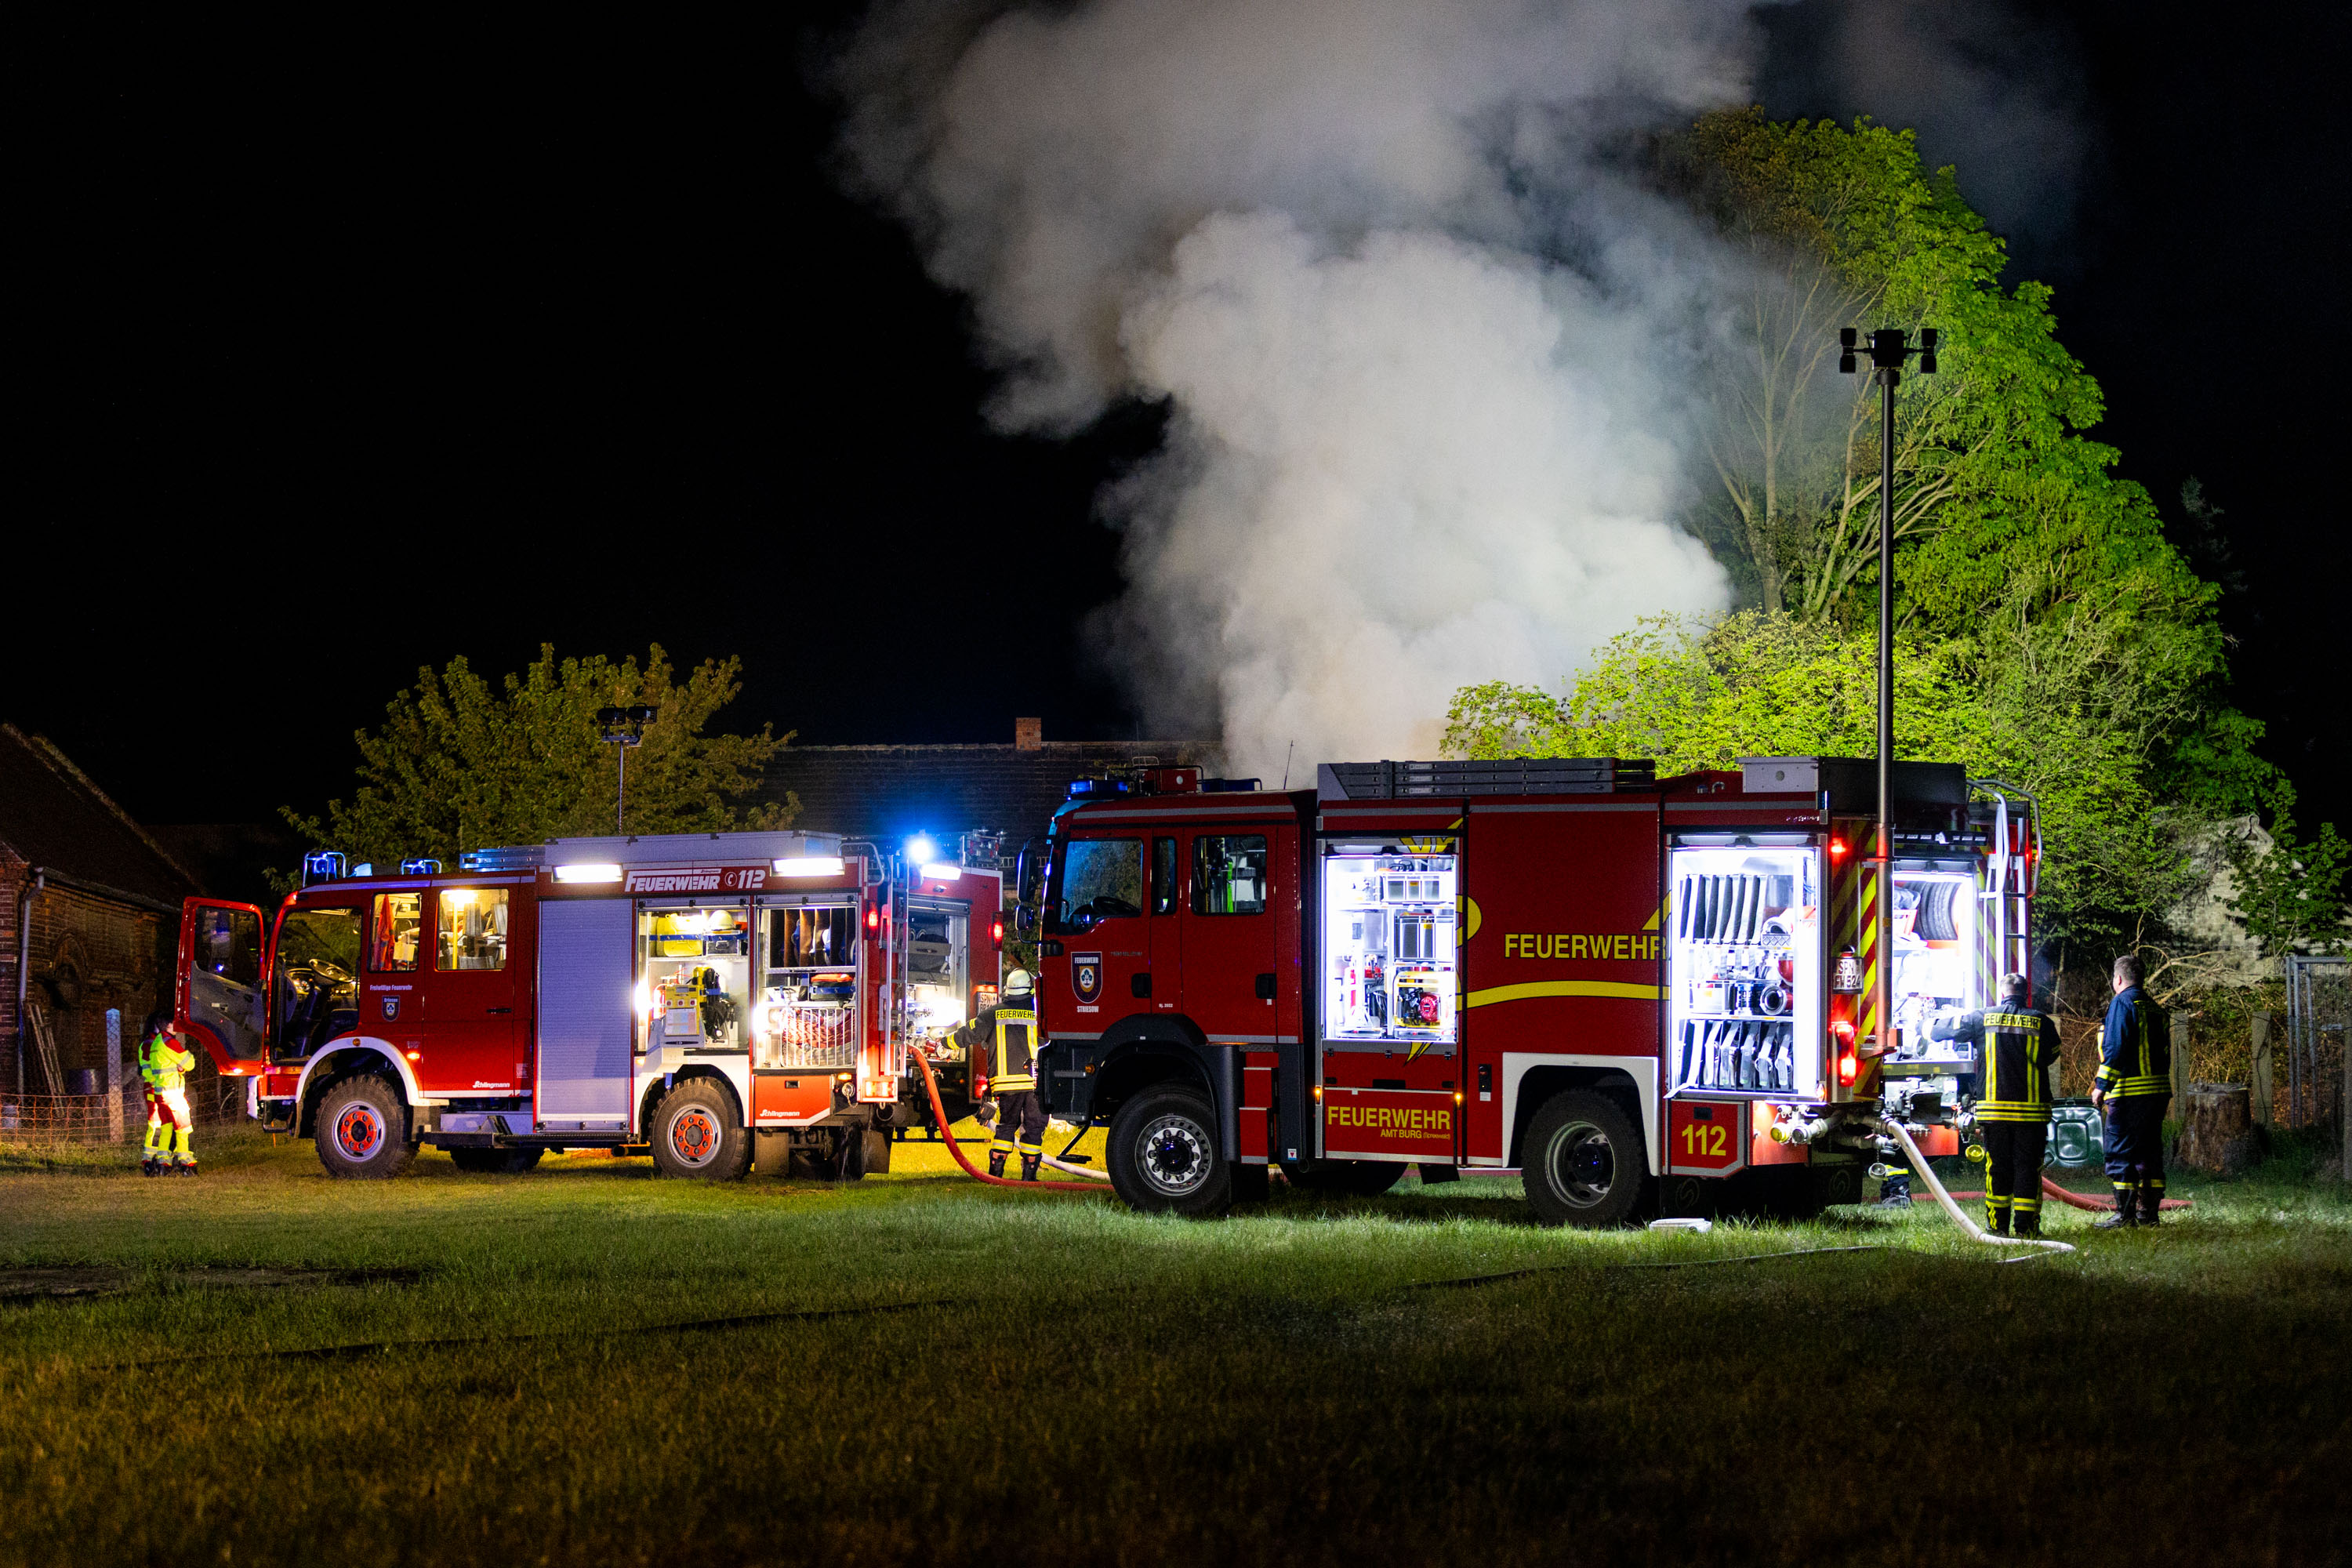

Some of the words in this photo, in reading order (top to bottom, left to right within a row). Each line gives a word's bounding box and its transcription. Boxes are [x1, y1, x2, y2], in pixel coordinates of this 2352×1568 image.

[624, 868, 722, 892] FEUERWEHR
[738, 869, 766, 889] 112
[1504, 934, 1667, 960] FEUERWEHR
[1846, 975, 1860, 988] 524
[996, 1010, 1036, 1019] FEUERWEHR
[1985, 1014, 2039, 1028] FEUERWEHR
[472, 1080, 510, 1089] Schlingmann
[760, 1109, 800, 1118] Schlingmann
[1327, 1106, 1450, 1130] FEUERWEHR
[1380, 1129, 1398, 1138] AMT
[1399, 1130, 1422, 1139] BURG
[1682, 1124, 1726, 1156] 112
